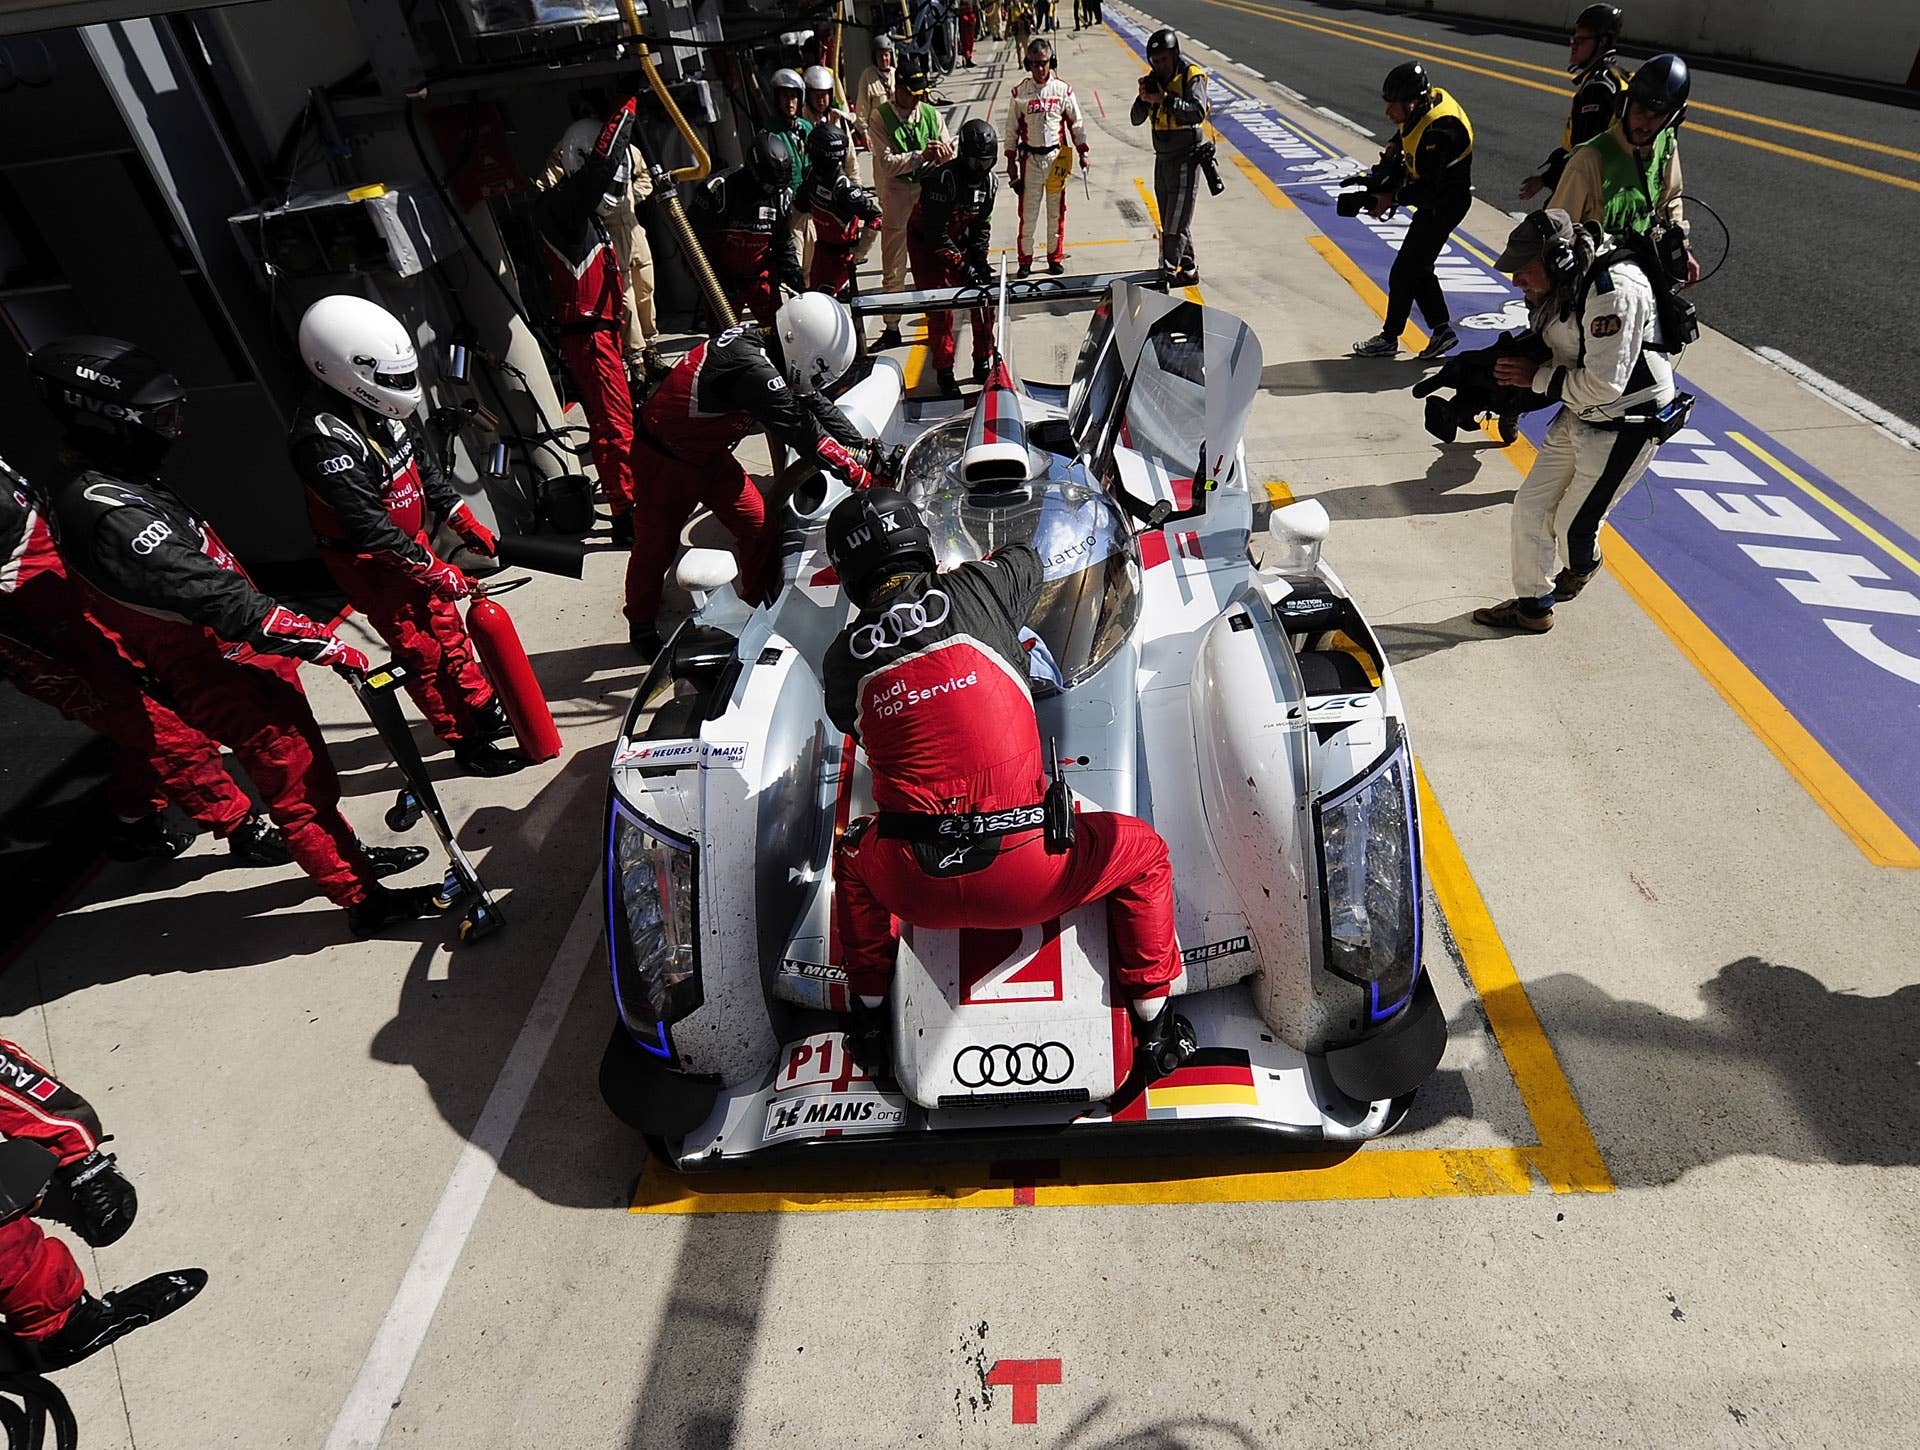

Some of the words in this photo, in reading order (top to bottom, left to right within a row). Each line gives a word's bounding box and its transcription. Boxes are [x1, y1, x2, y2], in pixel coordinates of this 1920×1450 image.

[76, 365, 122, 390] uvex
[64, 389, 144, 425] uvex
[355, 386, 381, 405] uvex
[846, 514, 901, 549] uvx
[873, 679, 907, 708] Audi
[876, 699, 904, 720] Top
[907, 673, 978, 705] Service
[619, 748, 652, 760] 24
[652, 745, 693, 758] HEURES
[711, 746, 745, 757] MANS
[803, 964, 848, 981] MICH
[787, 1039, 833, 1081] P1
